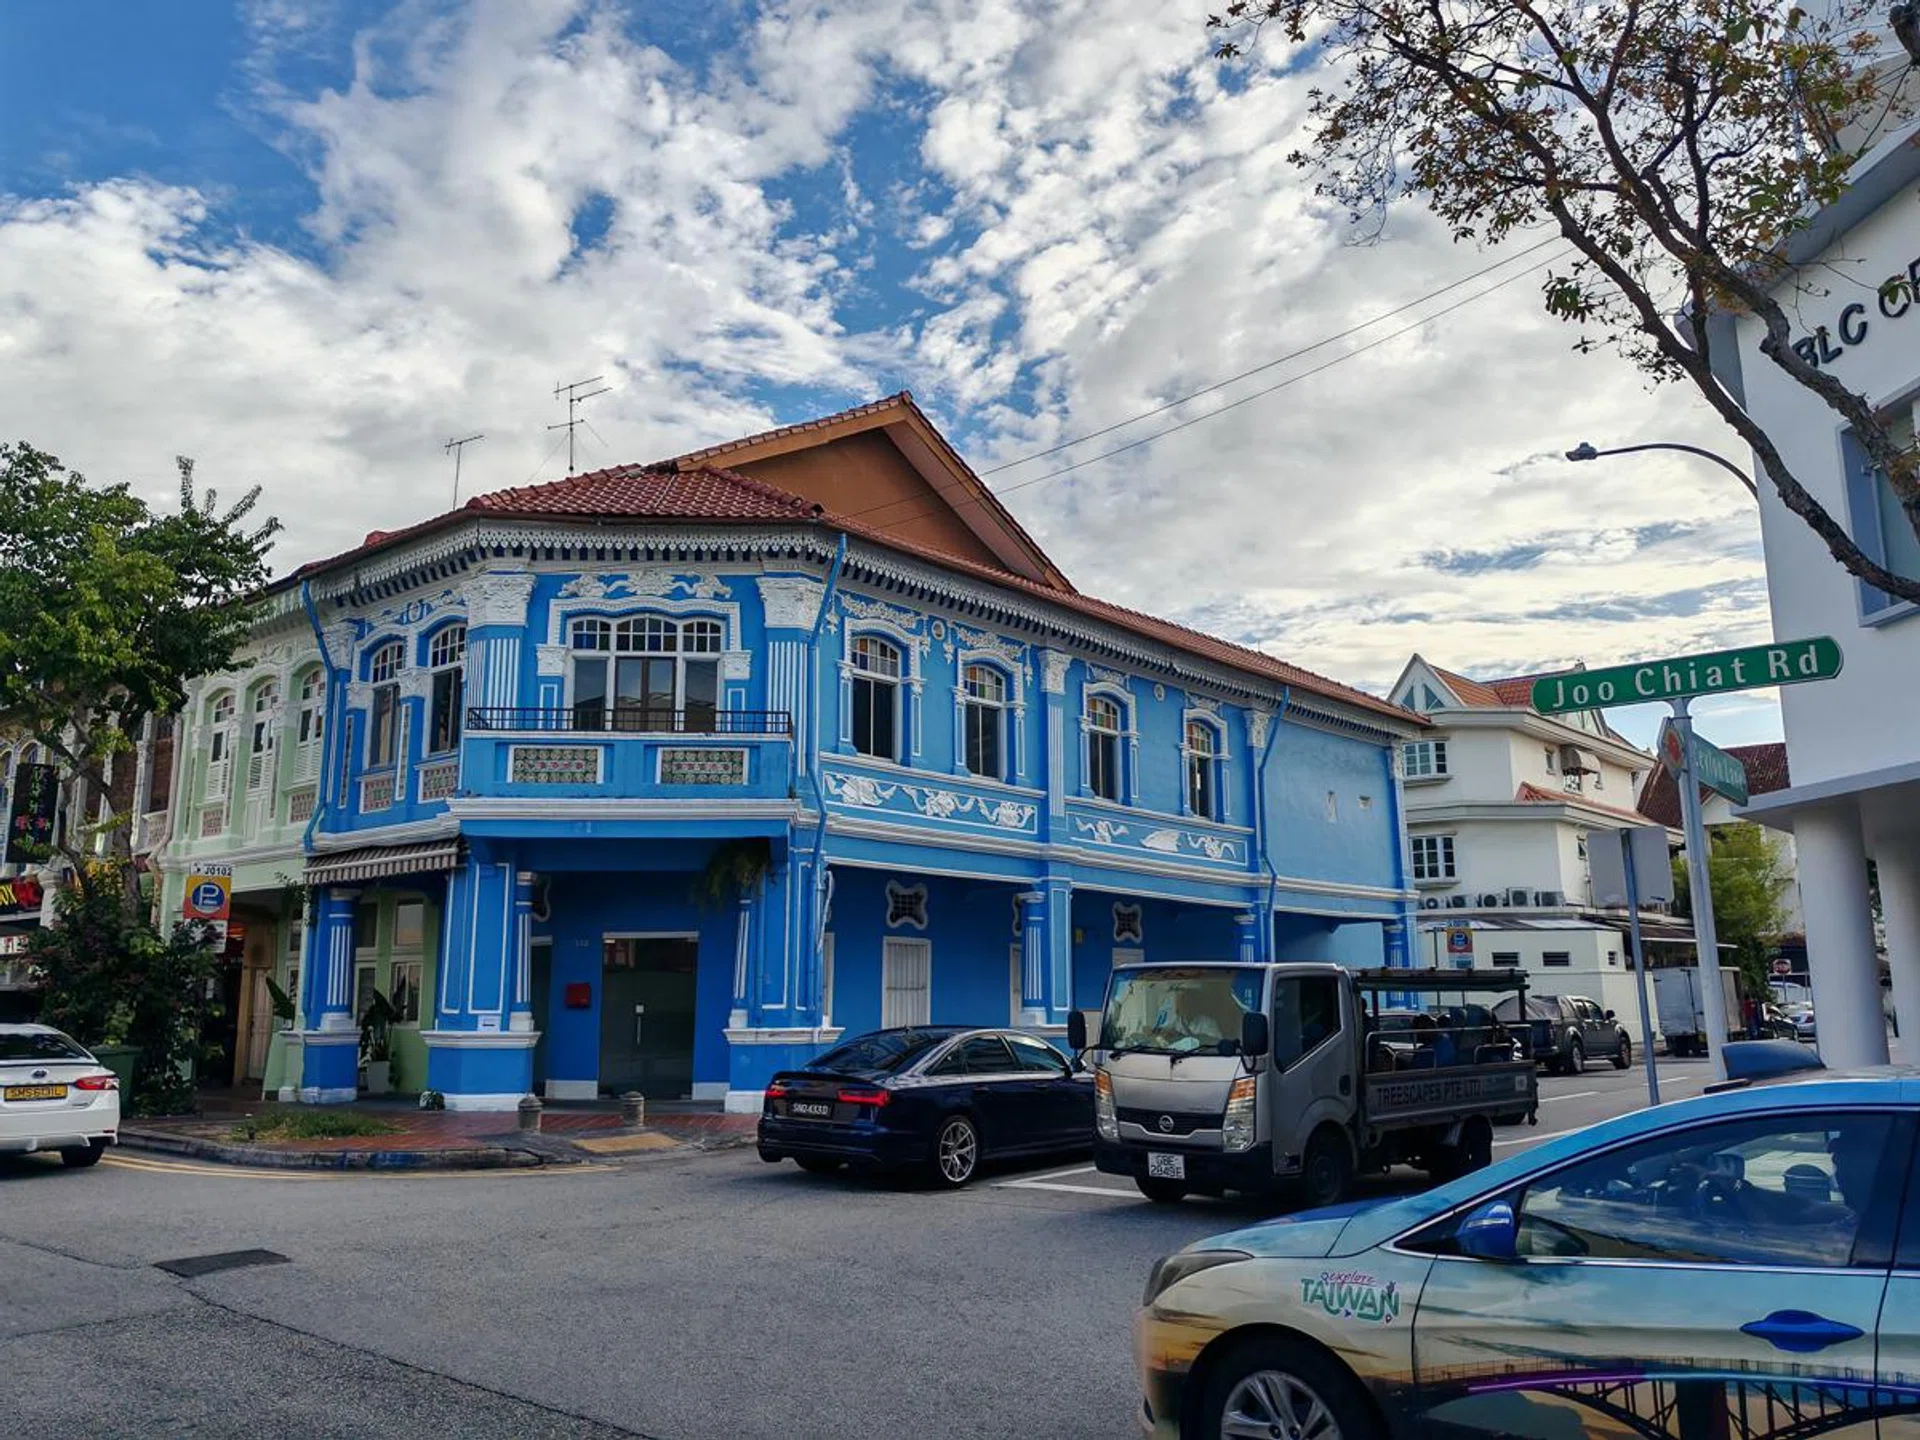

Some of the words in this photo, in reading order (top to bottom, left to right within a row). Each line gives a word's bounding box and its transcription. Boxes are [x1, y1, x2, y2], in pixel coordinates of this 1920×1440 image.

[1792, 302, 1868, 369] BLC
[1553, 680, 1615, 708] Joo
[1634, 656, 1747, 696] Chiat
[1767, 644, 1819, 679] Rd
[1377, 1084, 1440, 1106] TREESCAPES
[1444, 1081, 1461, 1101] PTE
[1301, 1279, 1399, 1321] TAIWAN
